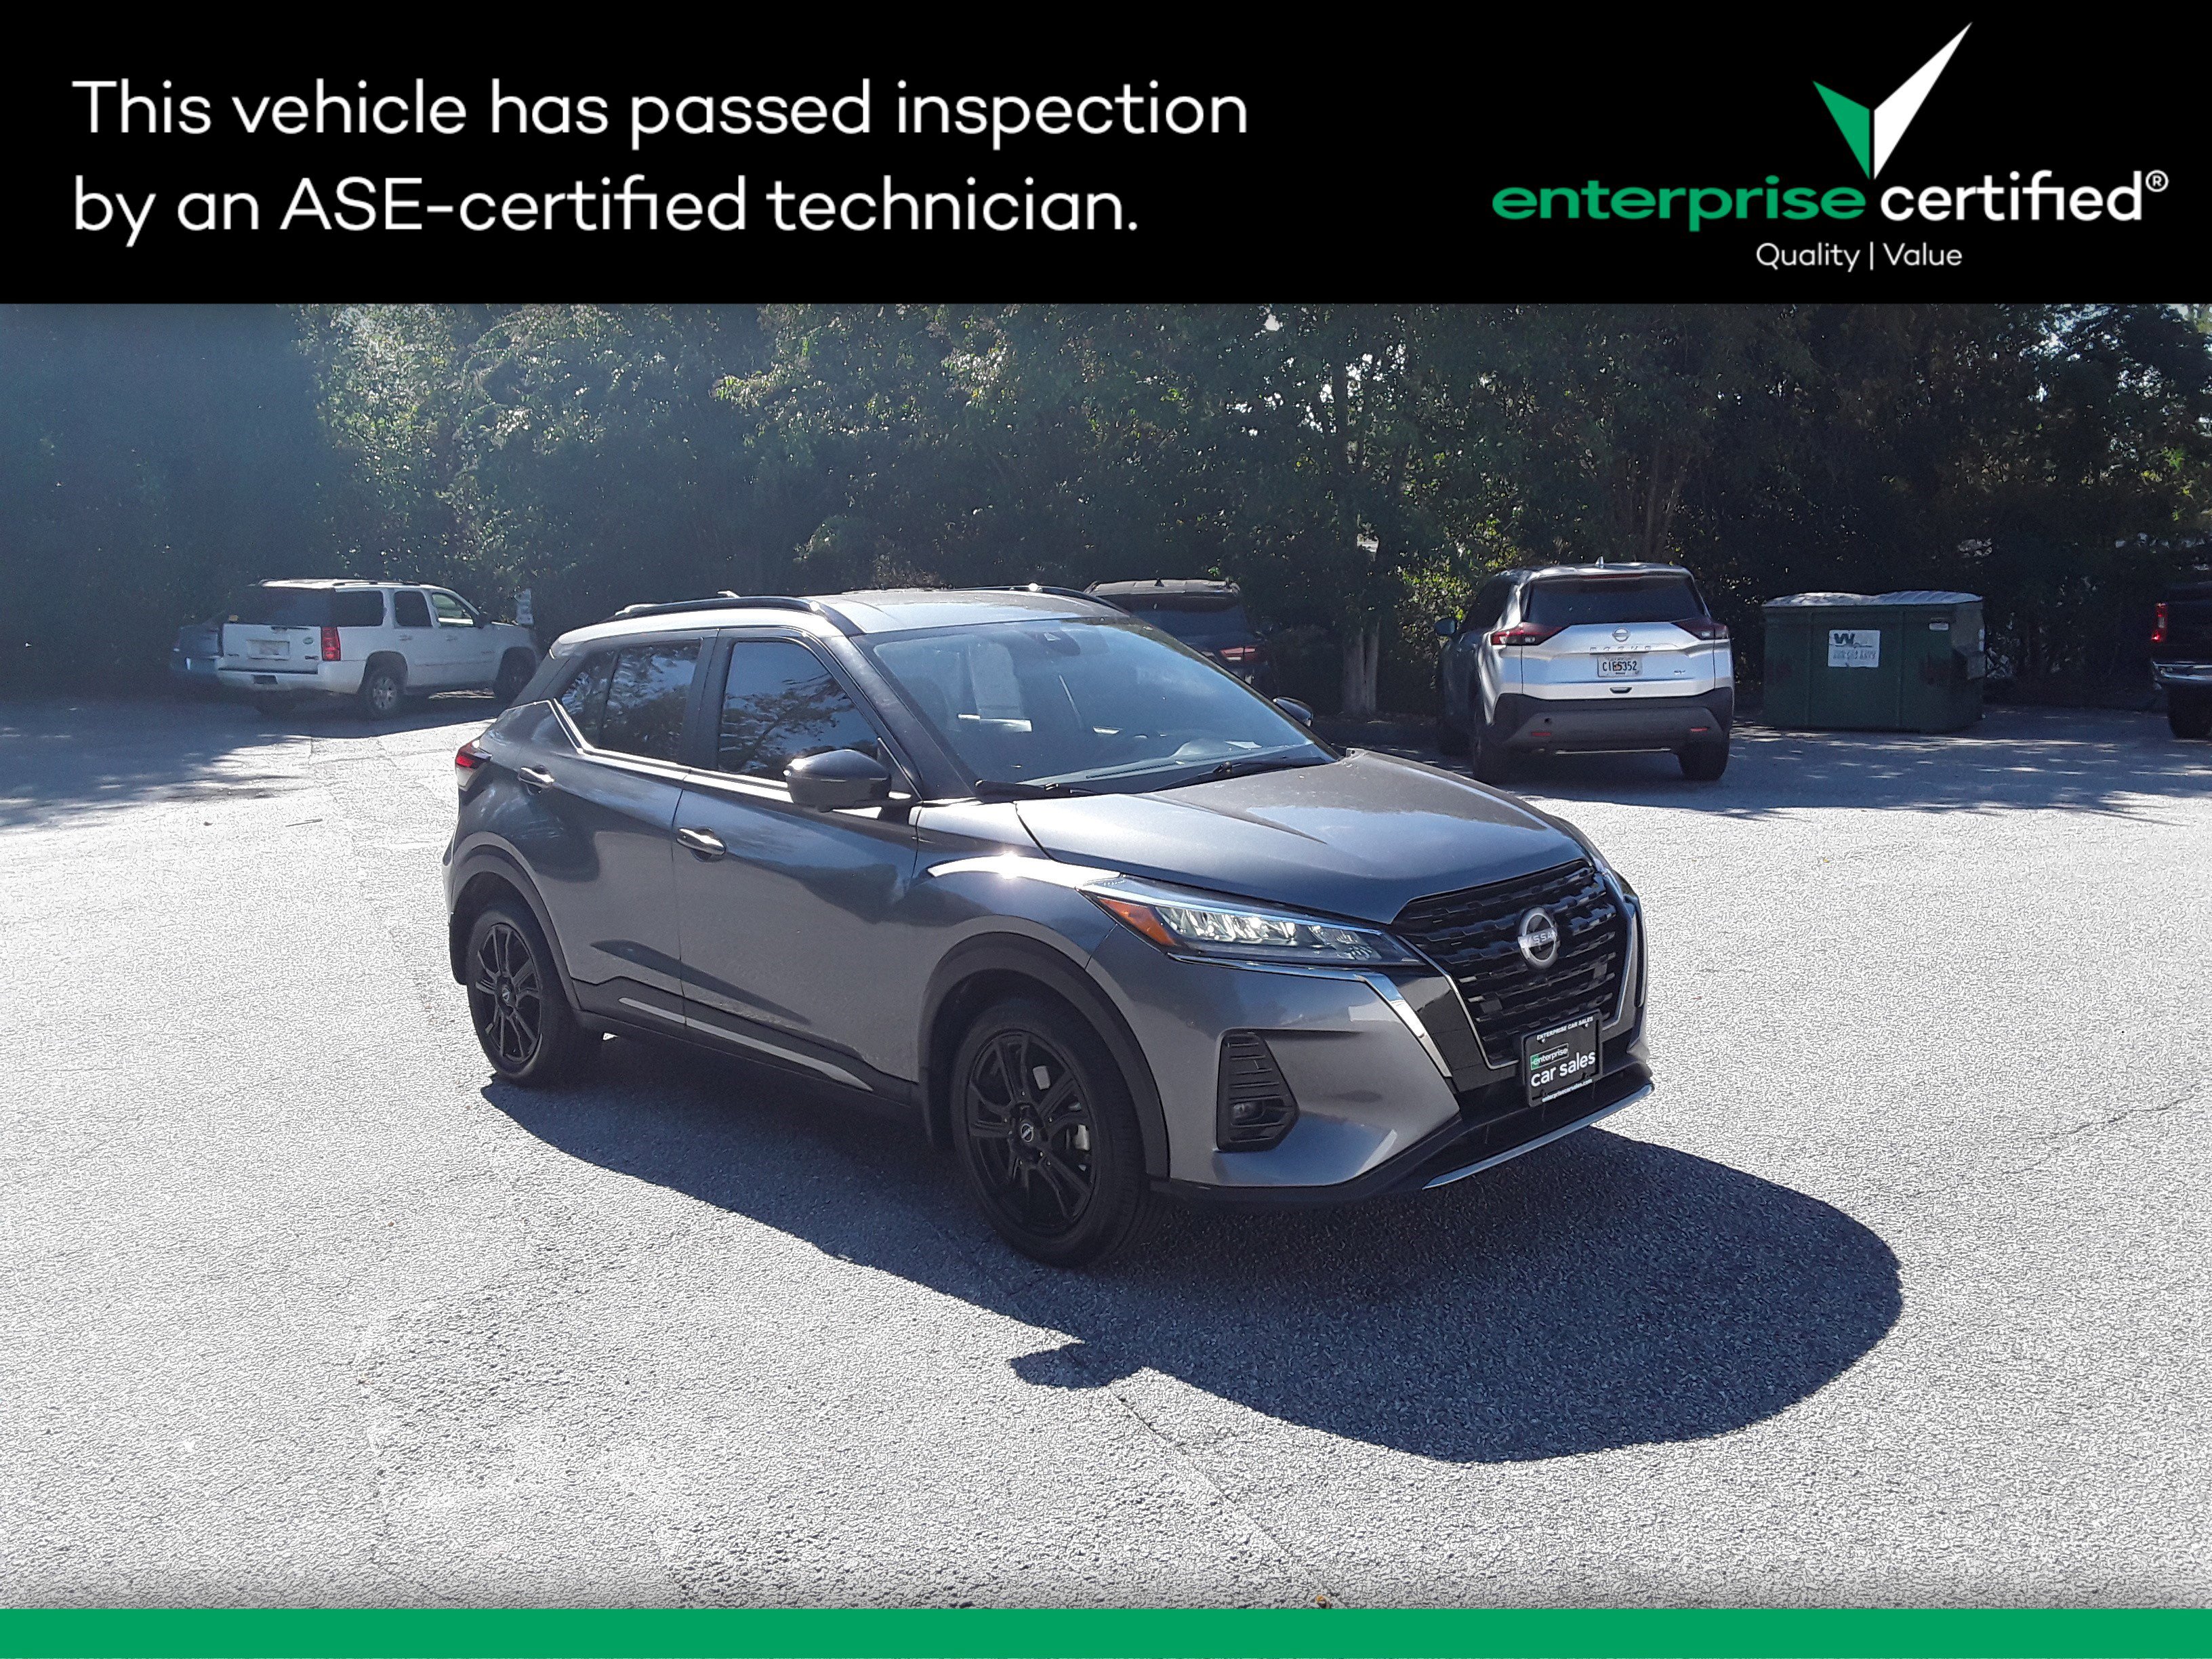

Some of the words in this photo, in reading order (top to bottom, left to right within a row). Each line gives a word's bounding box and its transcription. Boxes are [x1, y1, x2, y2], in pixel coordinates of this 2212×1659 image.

[1530, 1066, 1557, 1087] car
[1559, 1052, 1596, 1078] sales
[1532, 1048, 1569, 1065] enterprise
